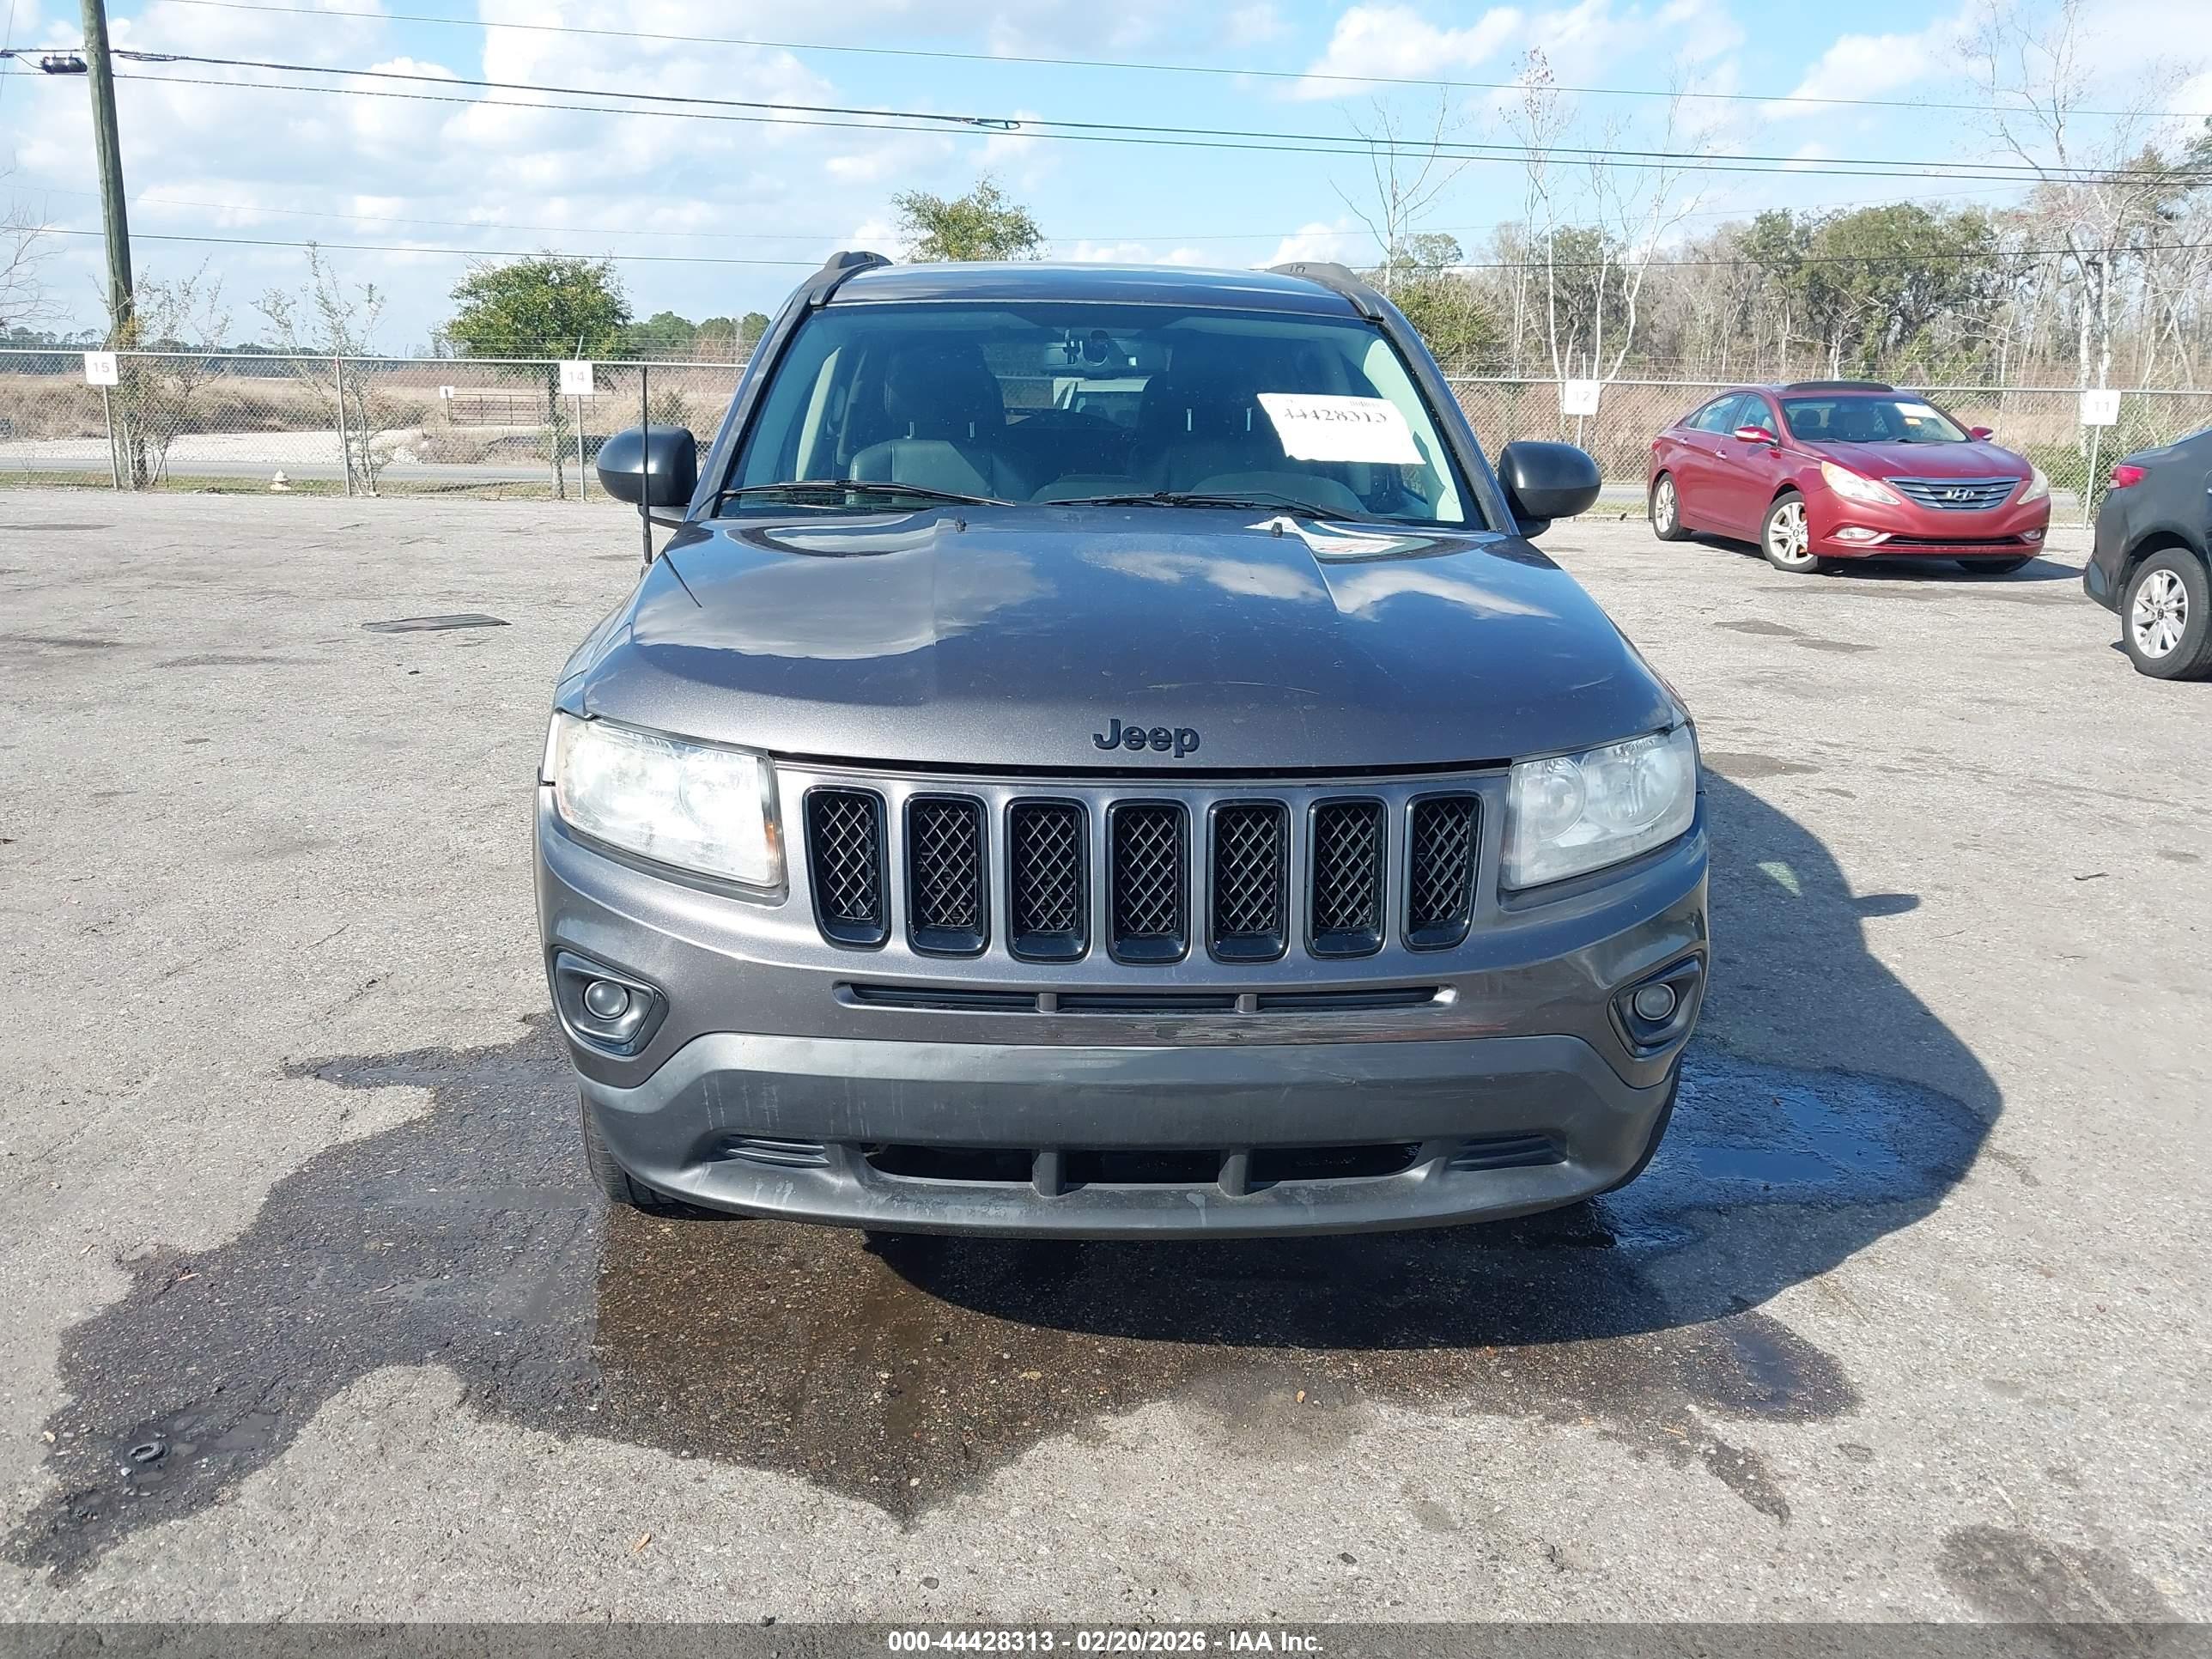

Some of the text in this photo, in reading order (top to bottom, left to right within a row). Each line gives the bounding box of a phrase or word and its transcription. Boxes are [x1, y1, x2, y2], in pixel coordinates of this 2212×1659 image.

[94, 362, 110, 373] 15
[568, 371, 585, 382] 14
[1091, 718, 1200, 758] Jeep
